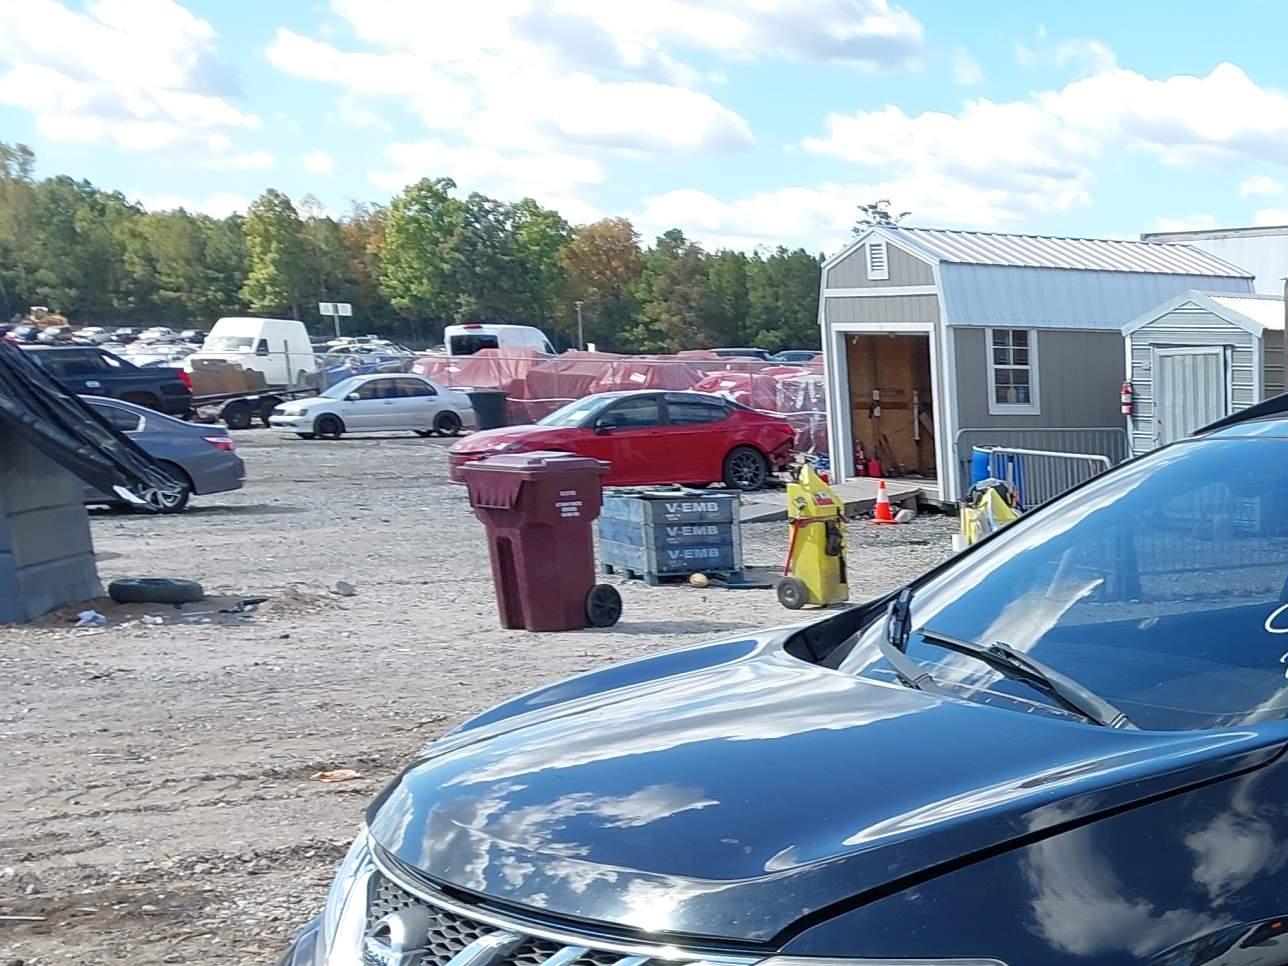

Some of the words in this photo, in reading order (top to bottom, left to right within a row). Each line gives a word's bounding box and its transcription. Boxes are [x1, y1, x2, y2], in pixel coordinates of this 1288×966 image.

[665, 502, 719, 513] V-EMB
[665, 525, 719, 537] V-EMB
[667, 548, 720, 559] V-EMB
